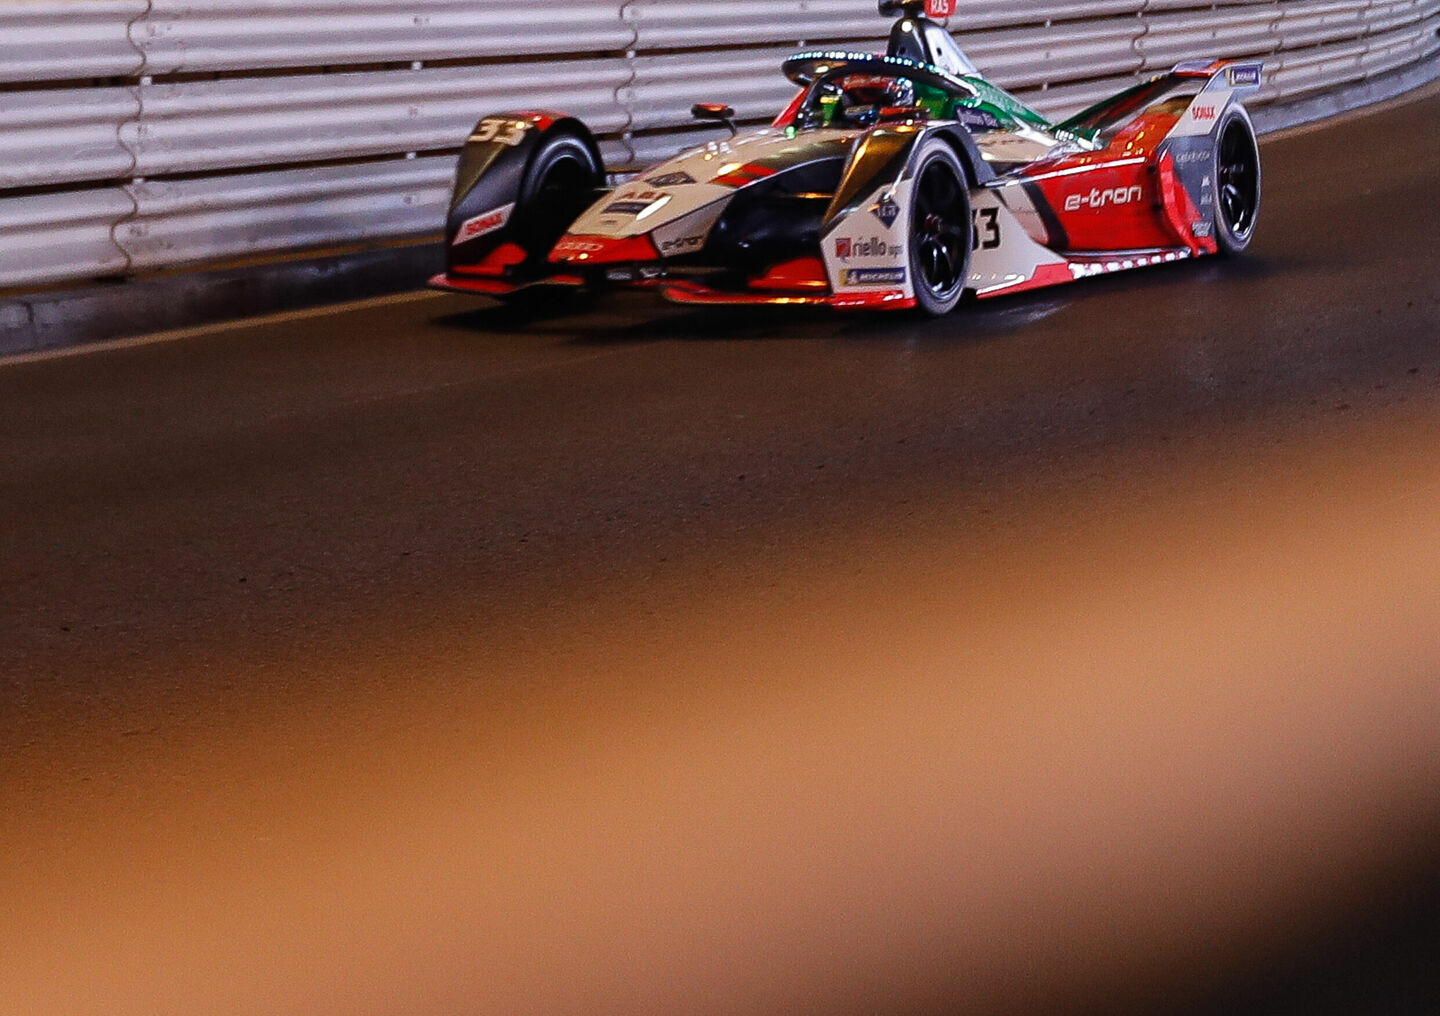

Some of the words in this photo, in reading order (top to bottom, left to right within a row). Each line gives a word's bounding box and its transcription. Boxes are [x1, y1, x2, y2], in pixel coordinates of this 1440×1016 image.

[467, 118, 534, 146] 33
[1064, 186, 1142, 212] e-tron
[972, 207, 1000, 251] 3
